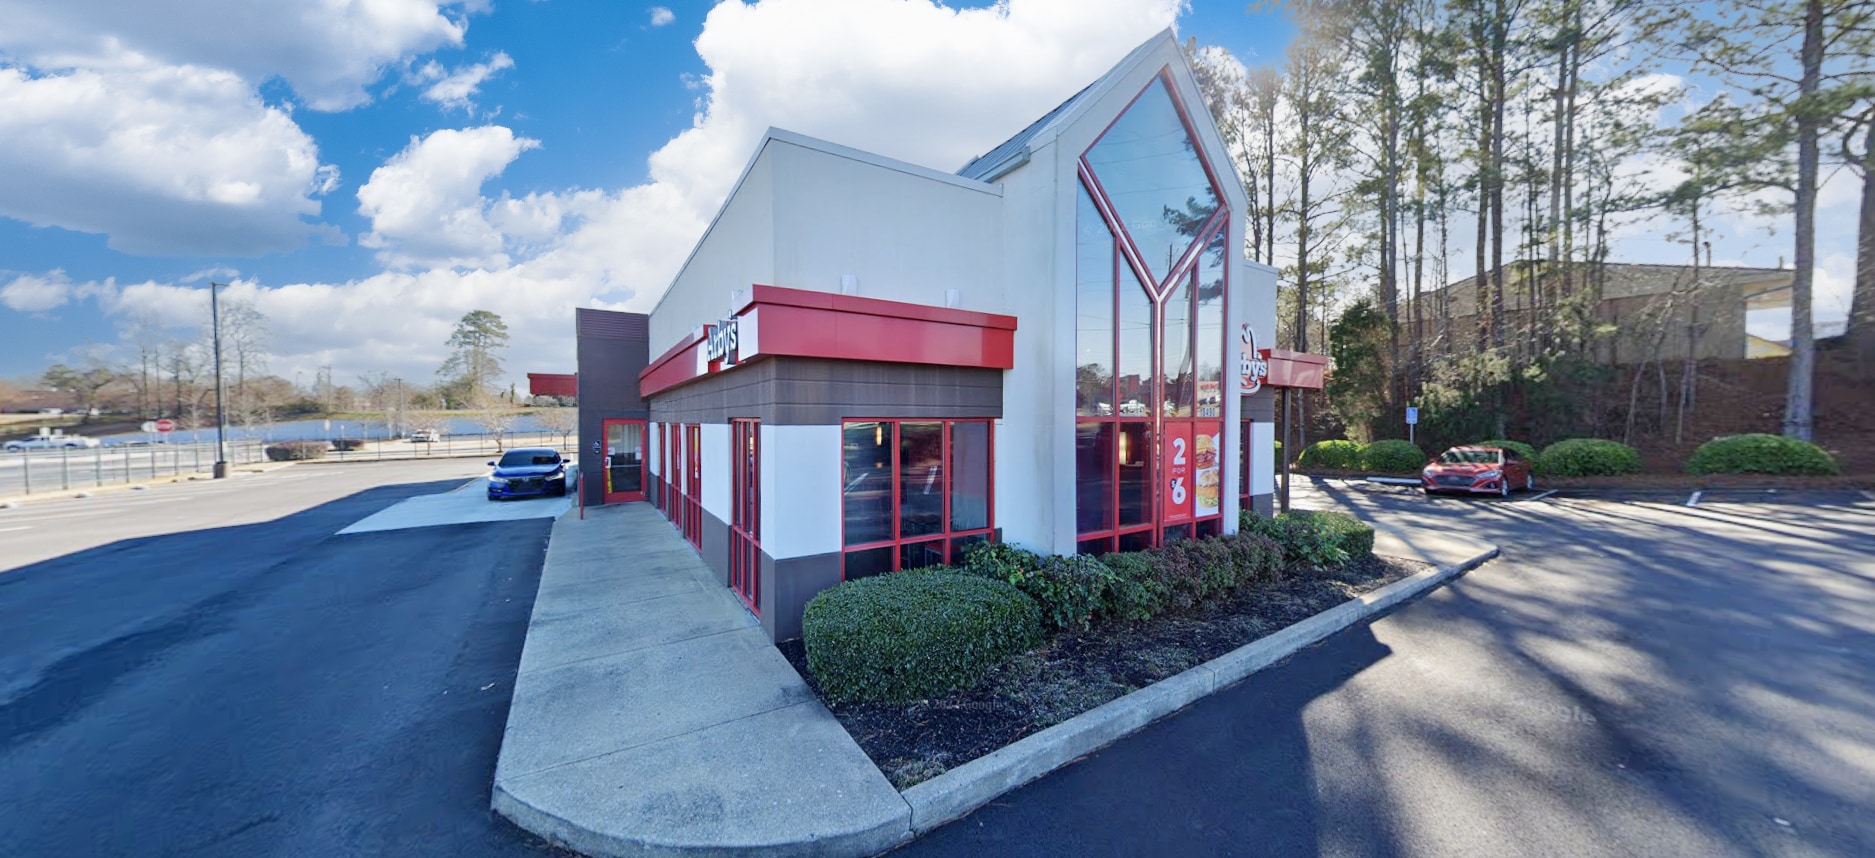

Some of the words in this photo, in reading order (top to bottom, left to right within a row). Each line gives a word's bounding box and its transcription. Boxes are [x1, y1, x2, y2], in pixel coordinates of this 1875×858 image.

[707, 310, 737, 365] Arby's
[1173, 437, 1186, 466] 2
[1170, 477, 1186, 504] $6
